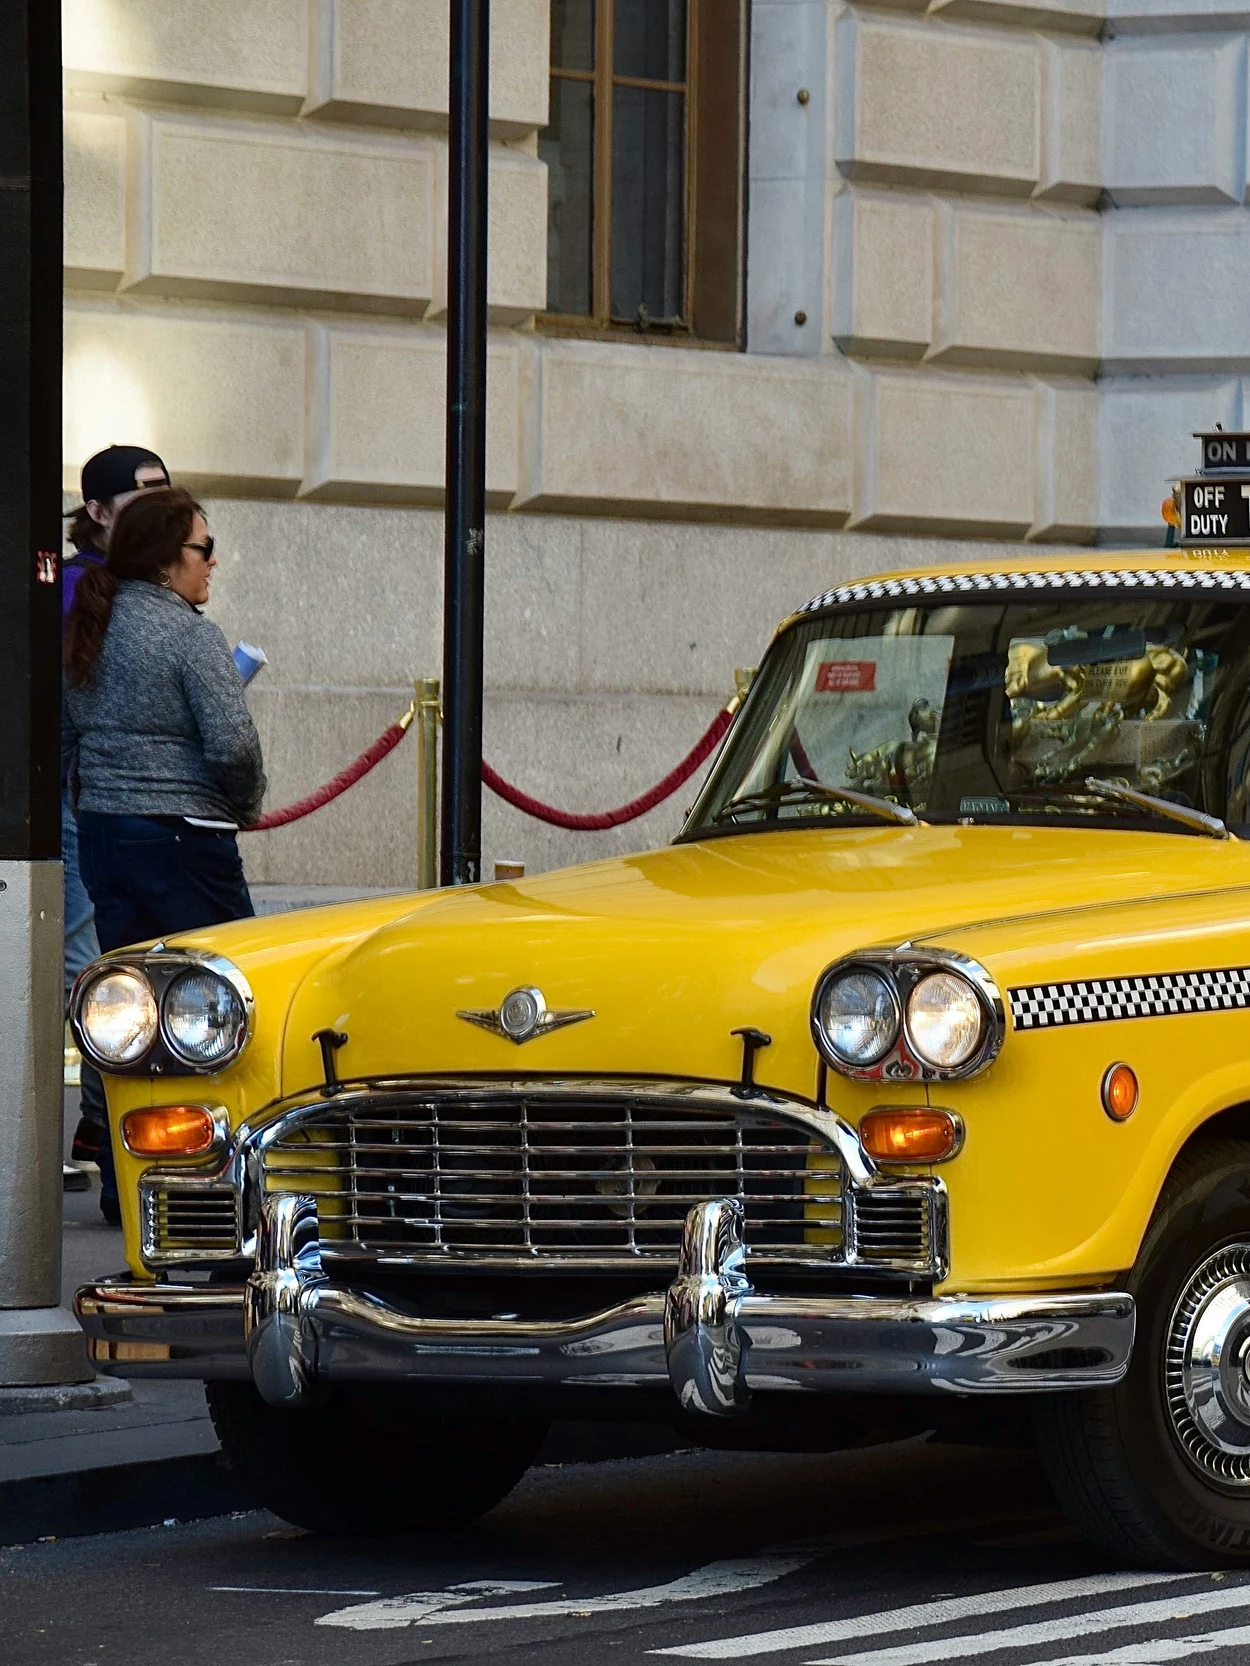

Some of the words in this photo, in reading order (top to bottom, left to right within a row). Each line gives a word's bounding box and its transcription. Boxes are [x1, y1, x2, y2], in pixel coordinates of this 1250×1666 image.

[1207, 441, 1237, 462] ON
[1193, 486, 1225, 508] OFF
[1190, 514, 1228, 535] DUTY
